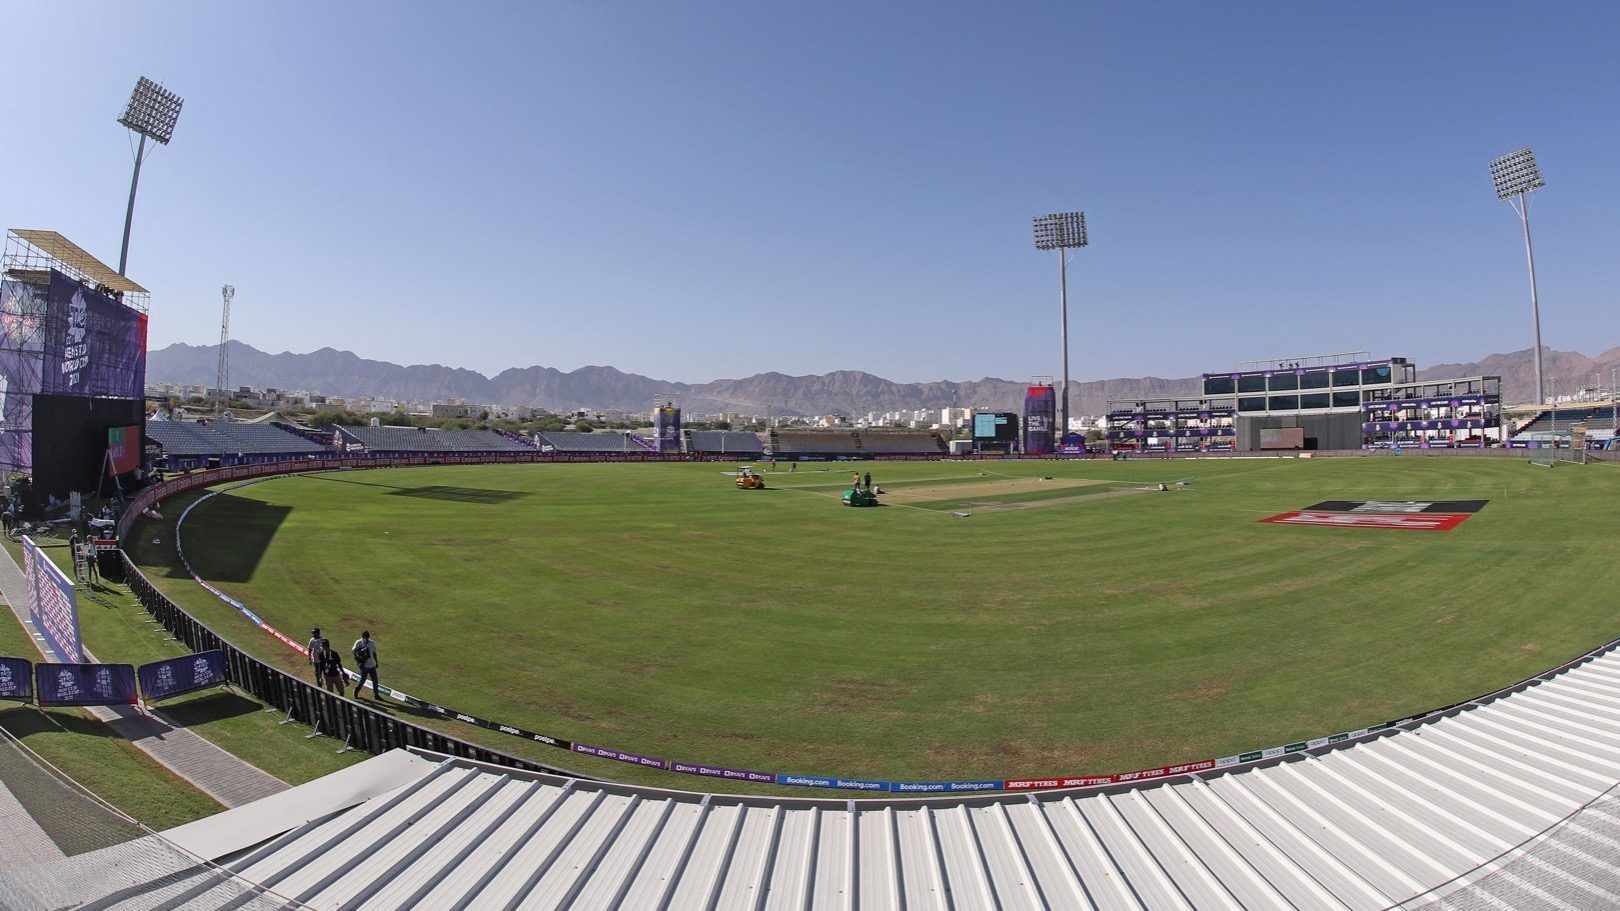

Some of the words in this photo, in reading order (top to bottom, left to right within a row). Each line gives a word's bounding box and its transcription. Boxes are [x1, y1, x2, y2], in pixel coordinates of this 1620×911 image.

[457, 713, 475, 723] postpe
[500, 725, 520, 735] postpe
[534, 734, 555, 744] postpe
[1191, 762, 1212, 770] TYRES
[1143, 769, 1164, 777] TYRES
[787, 777, 830, 786] Booking.com
[837, 781, 880, 789] Booking.com
